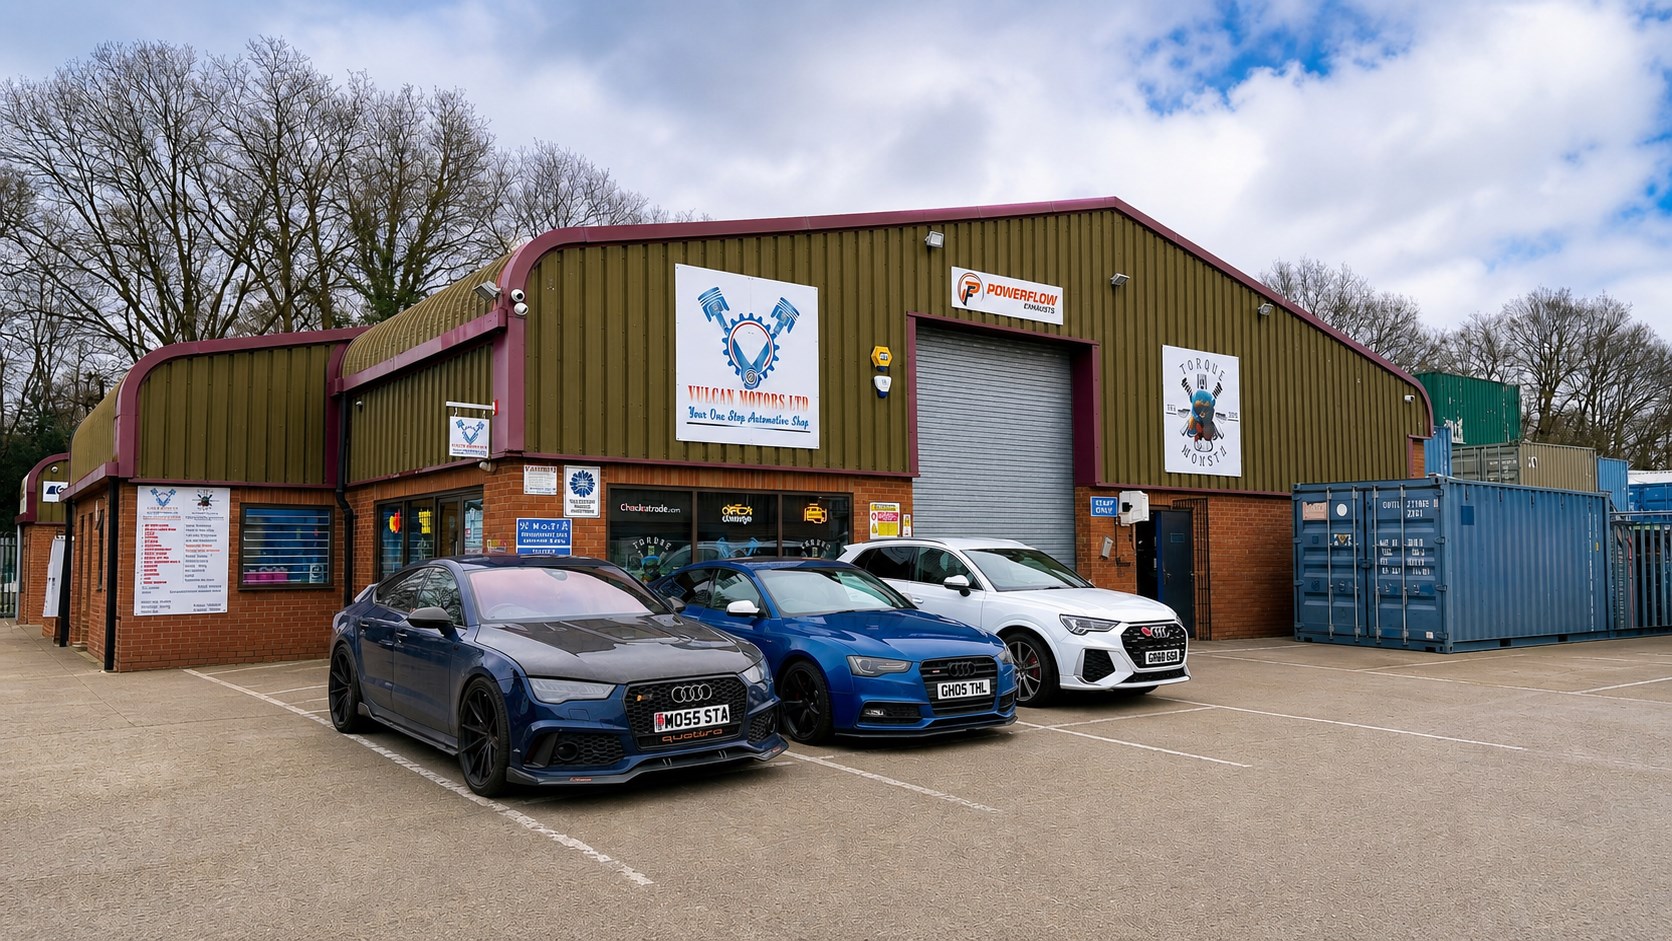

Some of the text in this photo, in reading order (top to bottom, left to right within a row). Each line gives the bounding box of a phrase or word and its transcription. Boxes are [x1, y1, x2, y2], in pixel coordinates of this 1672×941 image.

[986, 283, 1058, 306] POWERFLOW
[1179, 358, 1225, 381] TORQUE
[688, 385, 809, 412] VULCAN MOTORS LTD
[688, 406, 809, 429] Your One Stop Automotive Shop
[941, 681, 987, 697] GH05 THL
[664, 707, 728, 729] MO55 STA
[662, 729, 723, 743] quattro
